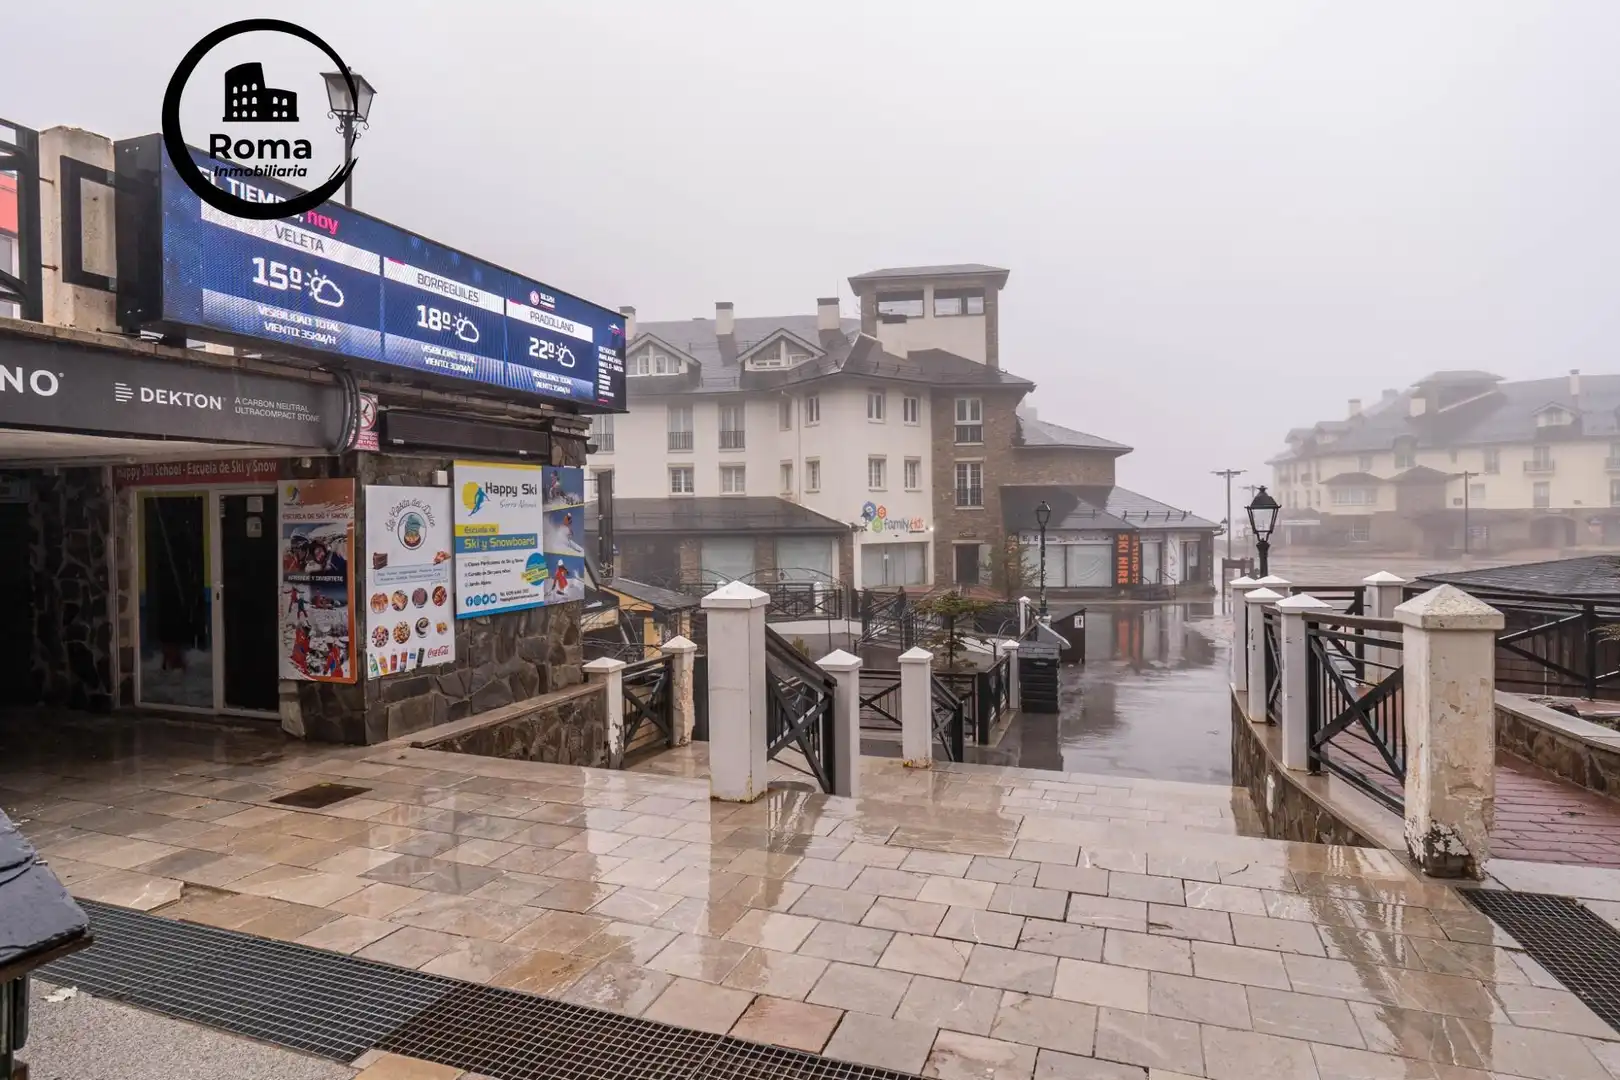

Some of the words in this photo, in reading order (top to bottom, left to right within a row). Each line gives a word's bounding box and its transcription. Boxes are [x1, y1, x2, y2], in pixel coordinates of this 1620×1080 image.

[274, 224, 325, 253] VELETA
[416, 273, 480, 303] BORREGUILES
[315, 316, 342, 332] TOTAL
[529, 310, 575, 333] PRADOLLANO
[140, 387, 222, 411] DEKTON
[234, 397, 241, 405] A
[242, 397, 275, 409] CARBON
[275, 402, 309, 413] NEUTRAL
[235, 406, 297, 420] ULTRACOMPACT
[297, 413, 320, 422] STONE
[154, 463, 182, 476] School
[187, 462, 217, 475] Escuela
[218, 462, 230, 474] de
[231, 460, 245, 473] Ski
[253, 460, 277, 473] Snow
[485, 482, 518, 497] Happy
[521, 483, 537, 495] Ski
[464, 526, 488, 534] Escuela
[464, 538, 479, 549] Ski
[481, 540, 488, 551] y
[490, 536, 535, 548] Snowboard
[1117, 534, 1129, 553] SKI
[1117, 556, 1129, 585] HIRE
